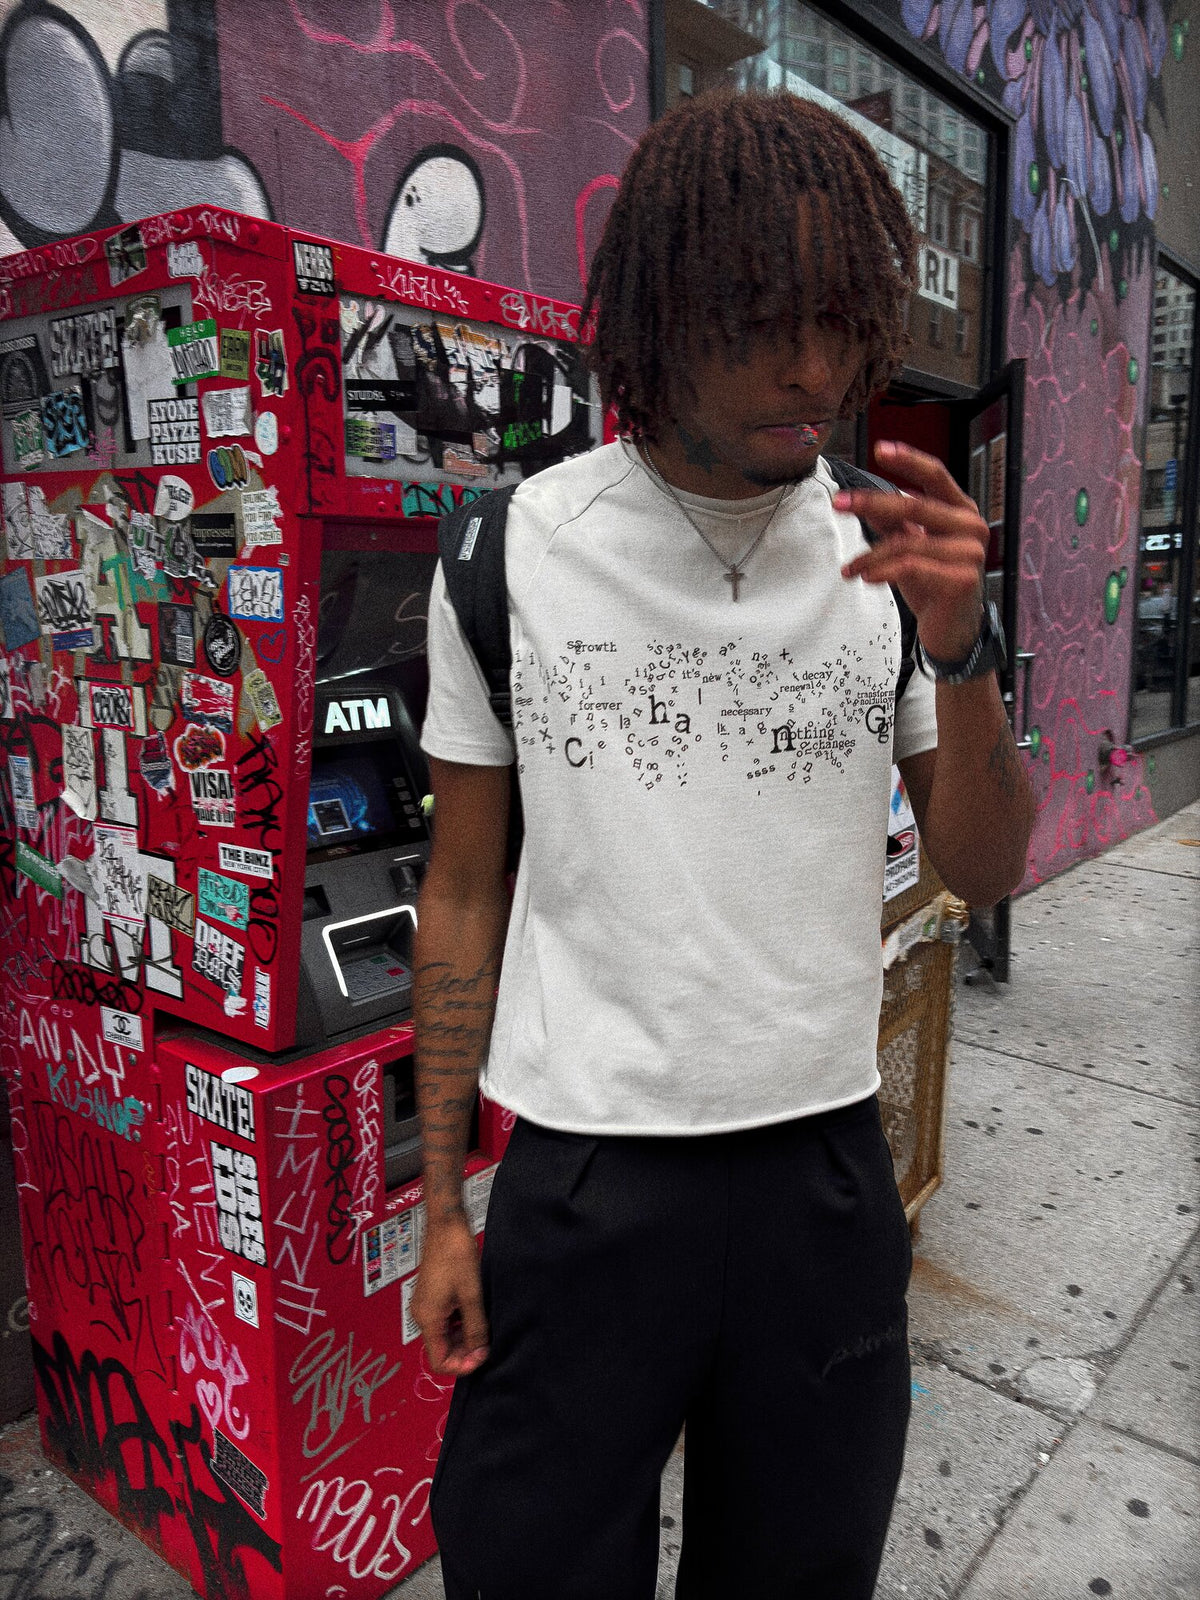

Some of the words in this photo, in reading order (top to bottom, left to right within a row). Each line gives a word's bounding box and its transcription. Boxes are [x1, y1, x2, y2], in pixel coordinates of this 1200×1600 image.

[702, 673, 722, 684] new
[802, 669, 833, 681] decay
[779, 681, 815, 693] renewal
[578, 700, 623, 711] forever
[720, 706, 772, 717] necessary
[324, 698, 392, 734] ATM
[779, 728, 835, 742] nothing
[812, 739, 856, 751] changes
[221, 846, 242, 862] THE
[185, 1063, 256, 1142] SKATE!
